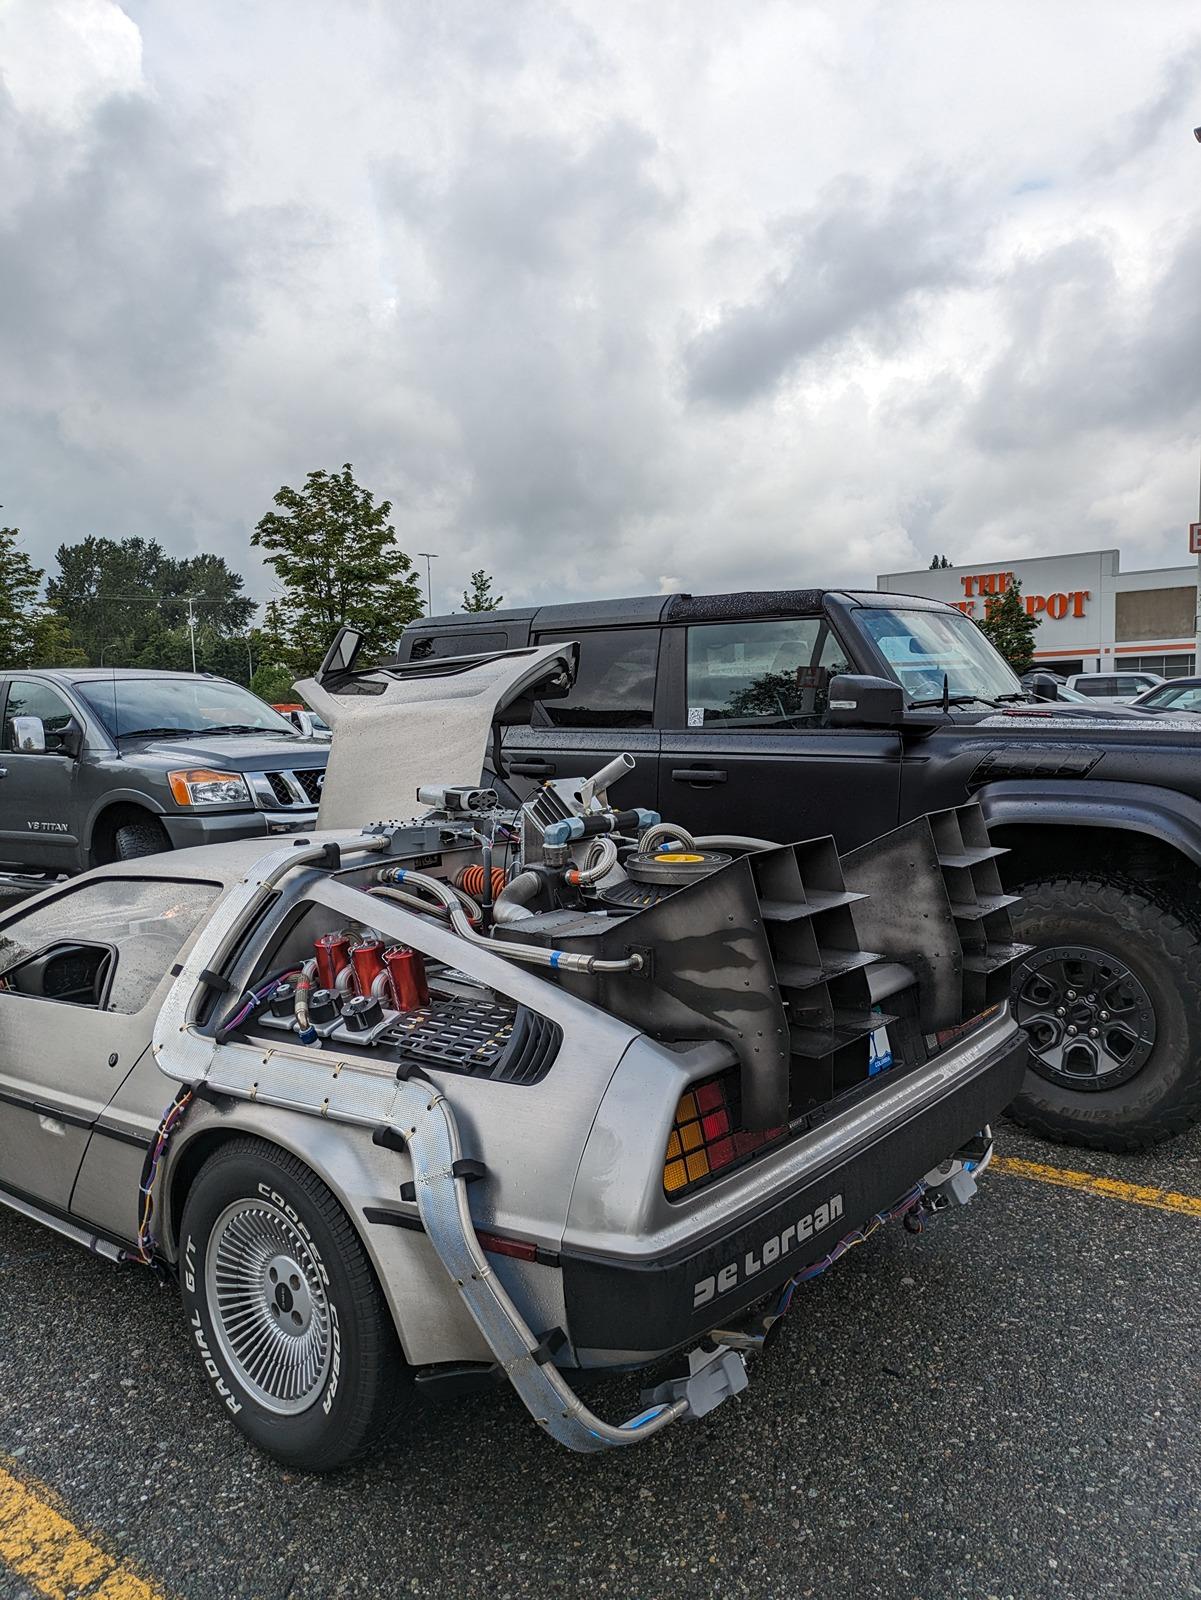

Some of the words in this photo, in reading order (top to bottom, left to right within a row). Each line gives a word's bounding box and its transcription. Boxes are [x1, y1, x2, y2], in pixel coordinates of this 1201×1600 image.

[960, 572, 1014, 597] THE
[984, 591, 1091, 620] DPOT
[41, 822, 68, 831] TITAN
[186, 1235, 197, 1293] G/T
[258, 1183, 329, 1286] COOPER
[323, 1303, 341, 1415] COBRA
[194, 1309, 242, 1414] RADIAL
